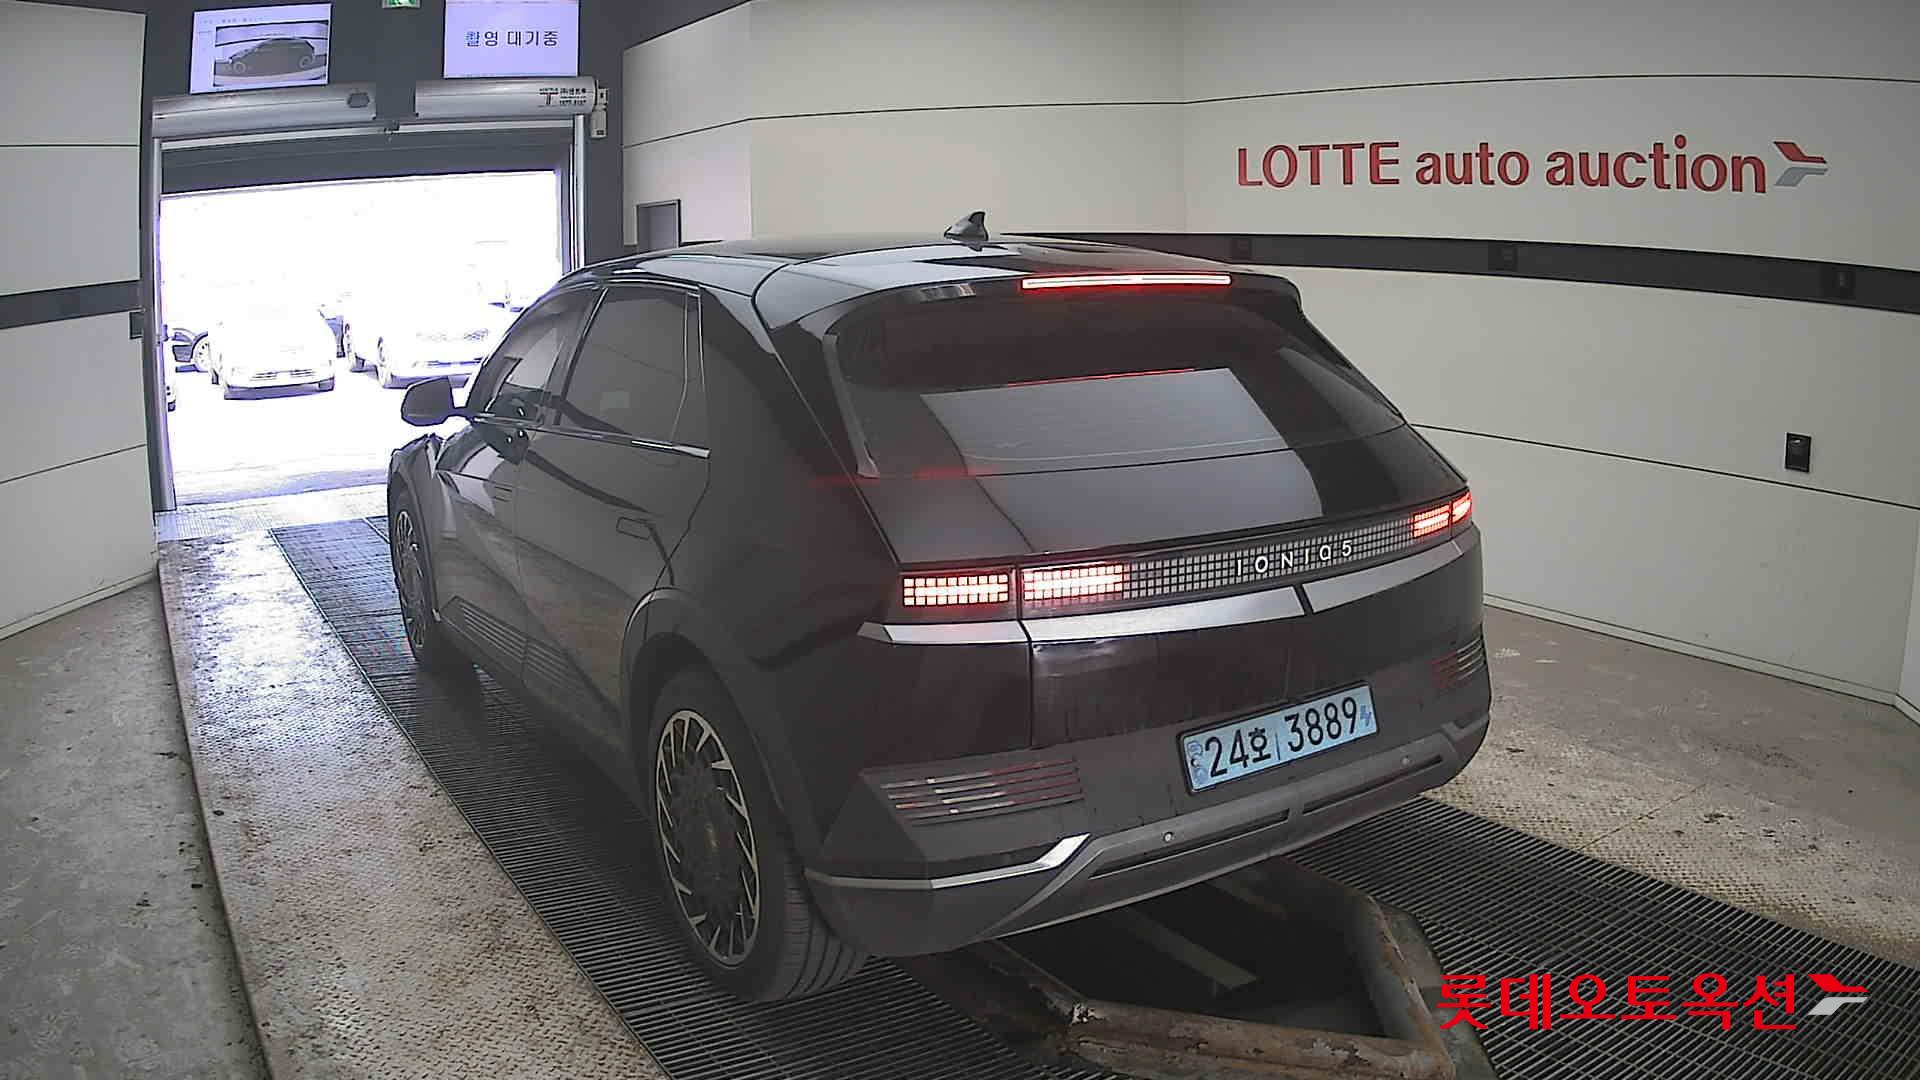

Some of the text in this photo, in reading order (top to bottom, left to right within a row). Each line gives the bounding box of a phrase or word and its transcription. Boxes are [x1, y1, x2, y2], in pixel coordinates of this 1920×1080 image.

[507, 31, 559, 47] 대기중
[1237, 135, 1768, 194] LOTTE auto auction
[1205, 697, 1357, 777] 24호 3889
